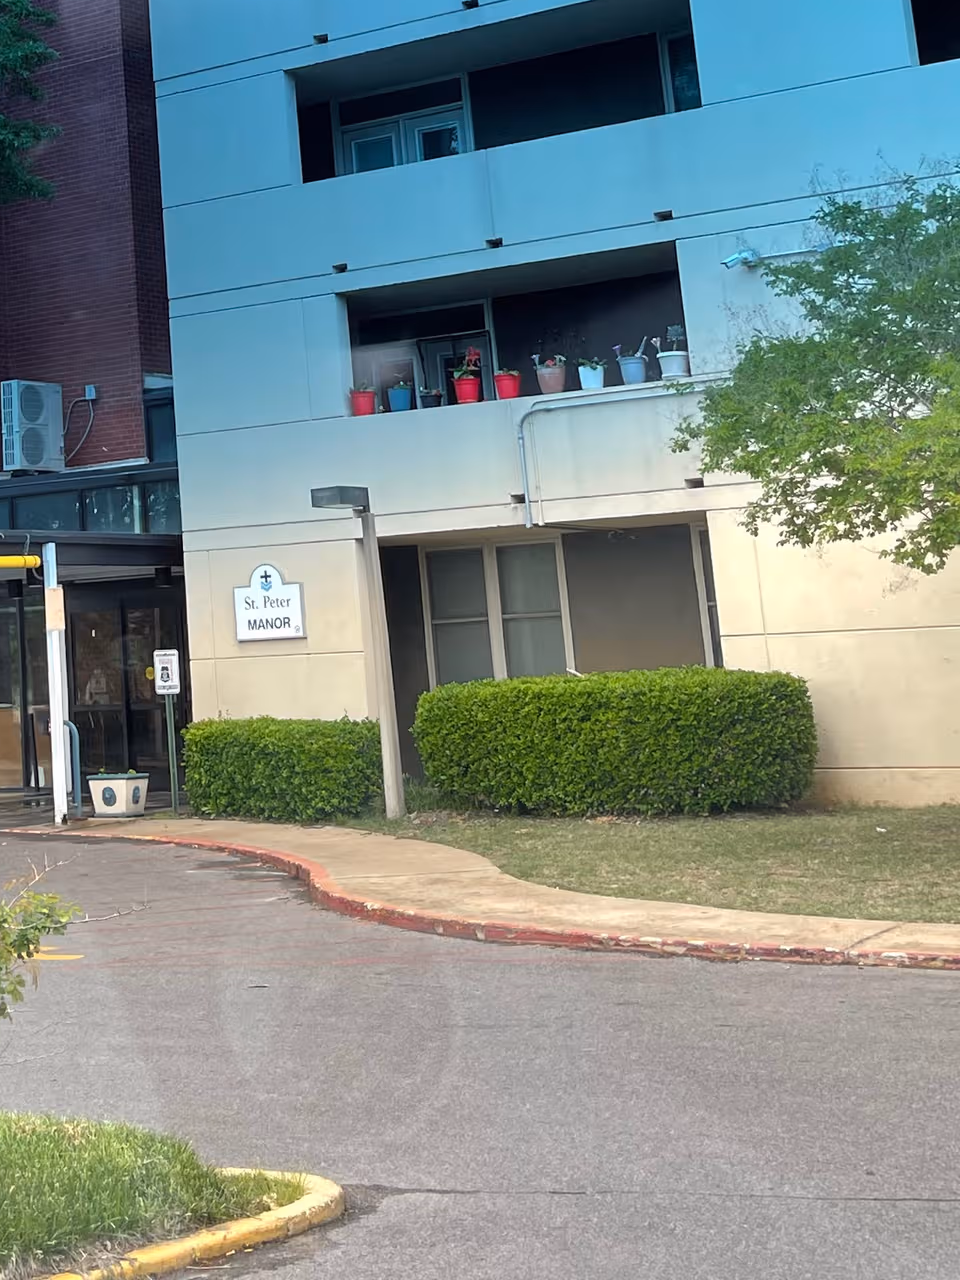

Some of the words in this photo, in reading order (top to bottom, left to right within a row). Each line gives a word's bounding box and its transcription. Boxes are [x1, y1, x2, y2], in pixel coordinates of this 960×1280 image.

[244, 595, 259, 610] St.
[263, 595, 291, 608] Peter
[248, 616, 291, 631] MANOR
